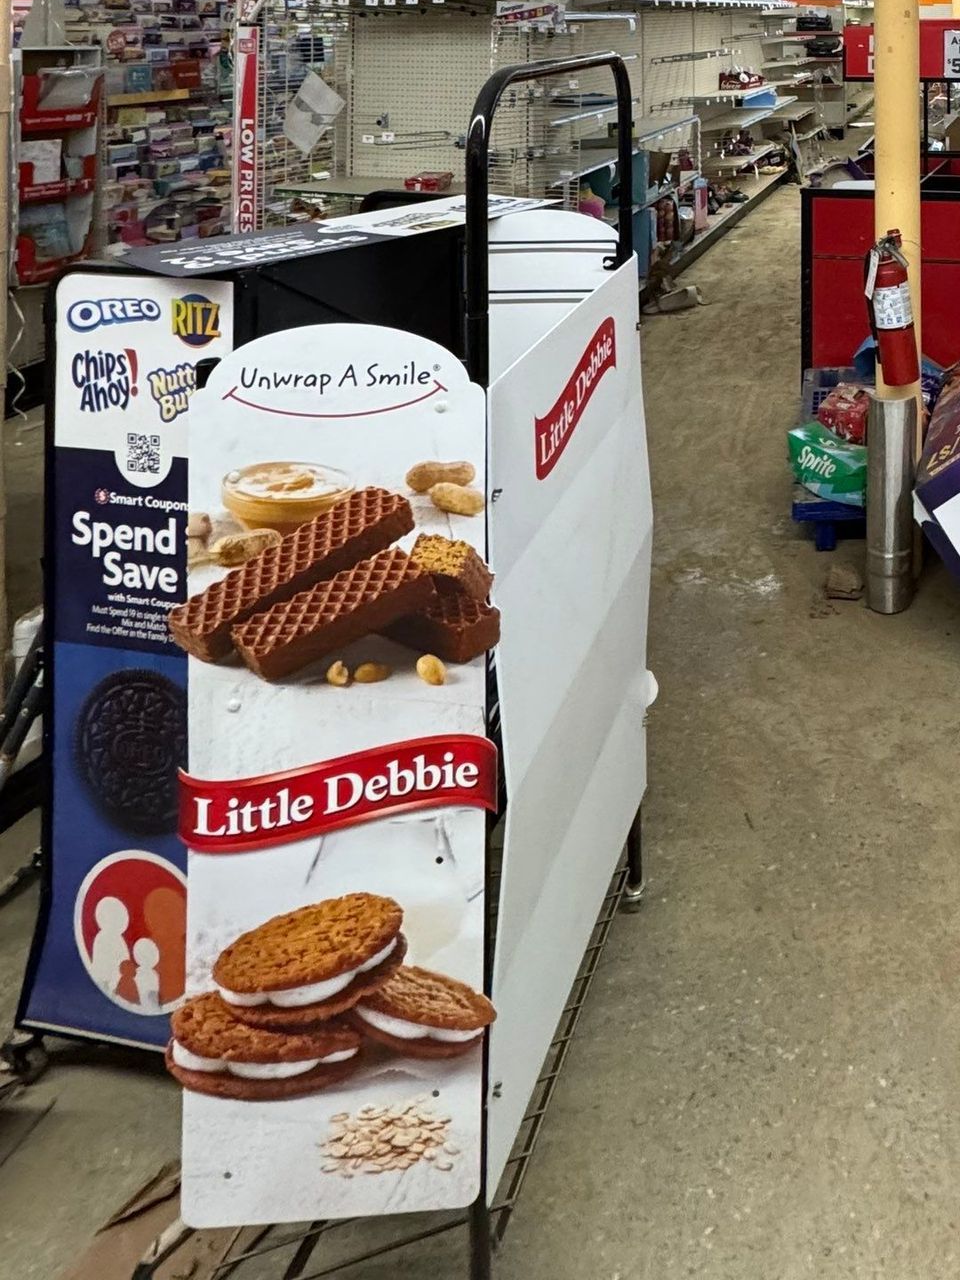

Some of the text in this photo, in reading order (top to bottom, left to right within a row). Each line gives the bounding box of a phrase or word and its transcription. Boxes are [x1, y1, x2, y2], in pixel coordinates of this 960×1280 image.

[239, 119, 255, 234] LOW PRICES
[67, 298, 222, 338] OREO RITZ
[71, 350, 127, 389] Chips
[241, 361, 431, 395] Unwrap A Smile
[540, 333, 613, 466] Little Debbie
[797, 445, 837, 479] Sprite
[110, 492, 143, 506] Smart
[72, 511, 177, 558] Spend
[103, 551, 178, 593] Save
[92, 604, 108, 614] Must
[109, 606, 128, 618] Spend
[143, 611, 161, 622] single
[108, 593, 126, 602] with
[126, 595, 150, 606] Smart
[86, 623, 101, 633] Find
[100, 625, 112, 634] the
[112, 626, 129, 636] Offer
[136, 629, 147, 638] the
[147, 631, 168, 643] Family
[121, 618, 167, 631] Mix and Match
[193, 752, 479, 837] Little Debbie
